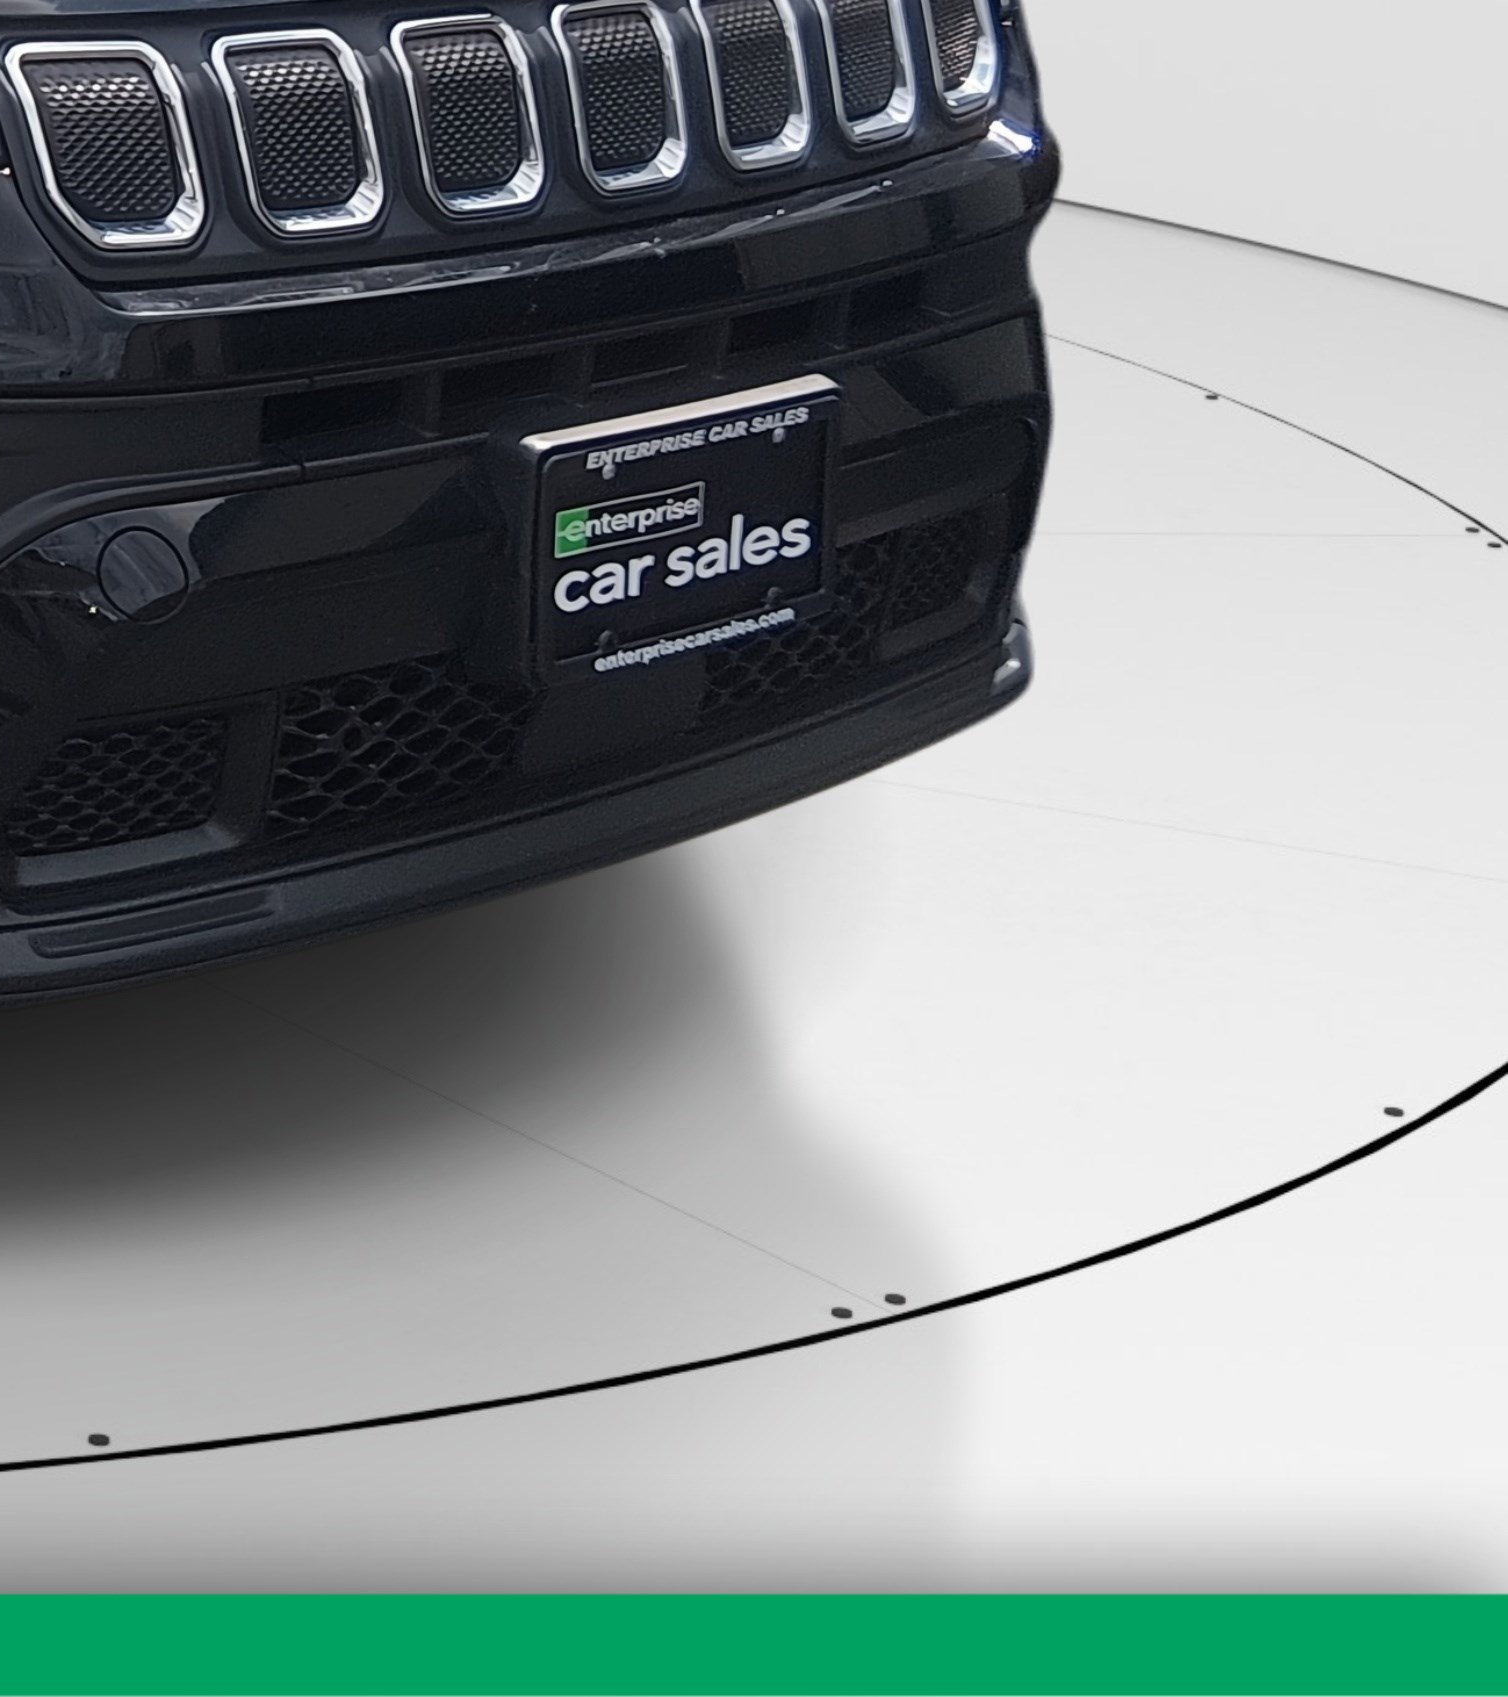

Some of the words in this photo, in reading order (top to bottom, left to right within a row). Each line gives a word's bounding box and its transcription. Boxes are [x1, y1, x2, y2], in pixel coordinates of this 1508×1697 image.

[586, 429, 706, 470] ENTERPRISE
[708, 421, 748, 444] CAR
[749, 407, 810, 434] SALES
[558, 497, 701, 542] enterprise
[554, 554, 655, 613] car
[664, 514, 811, 588] sales
[594, 607, 795, 672] enterprisecarsales.com
